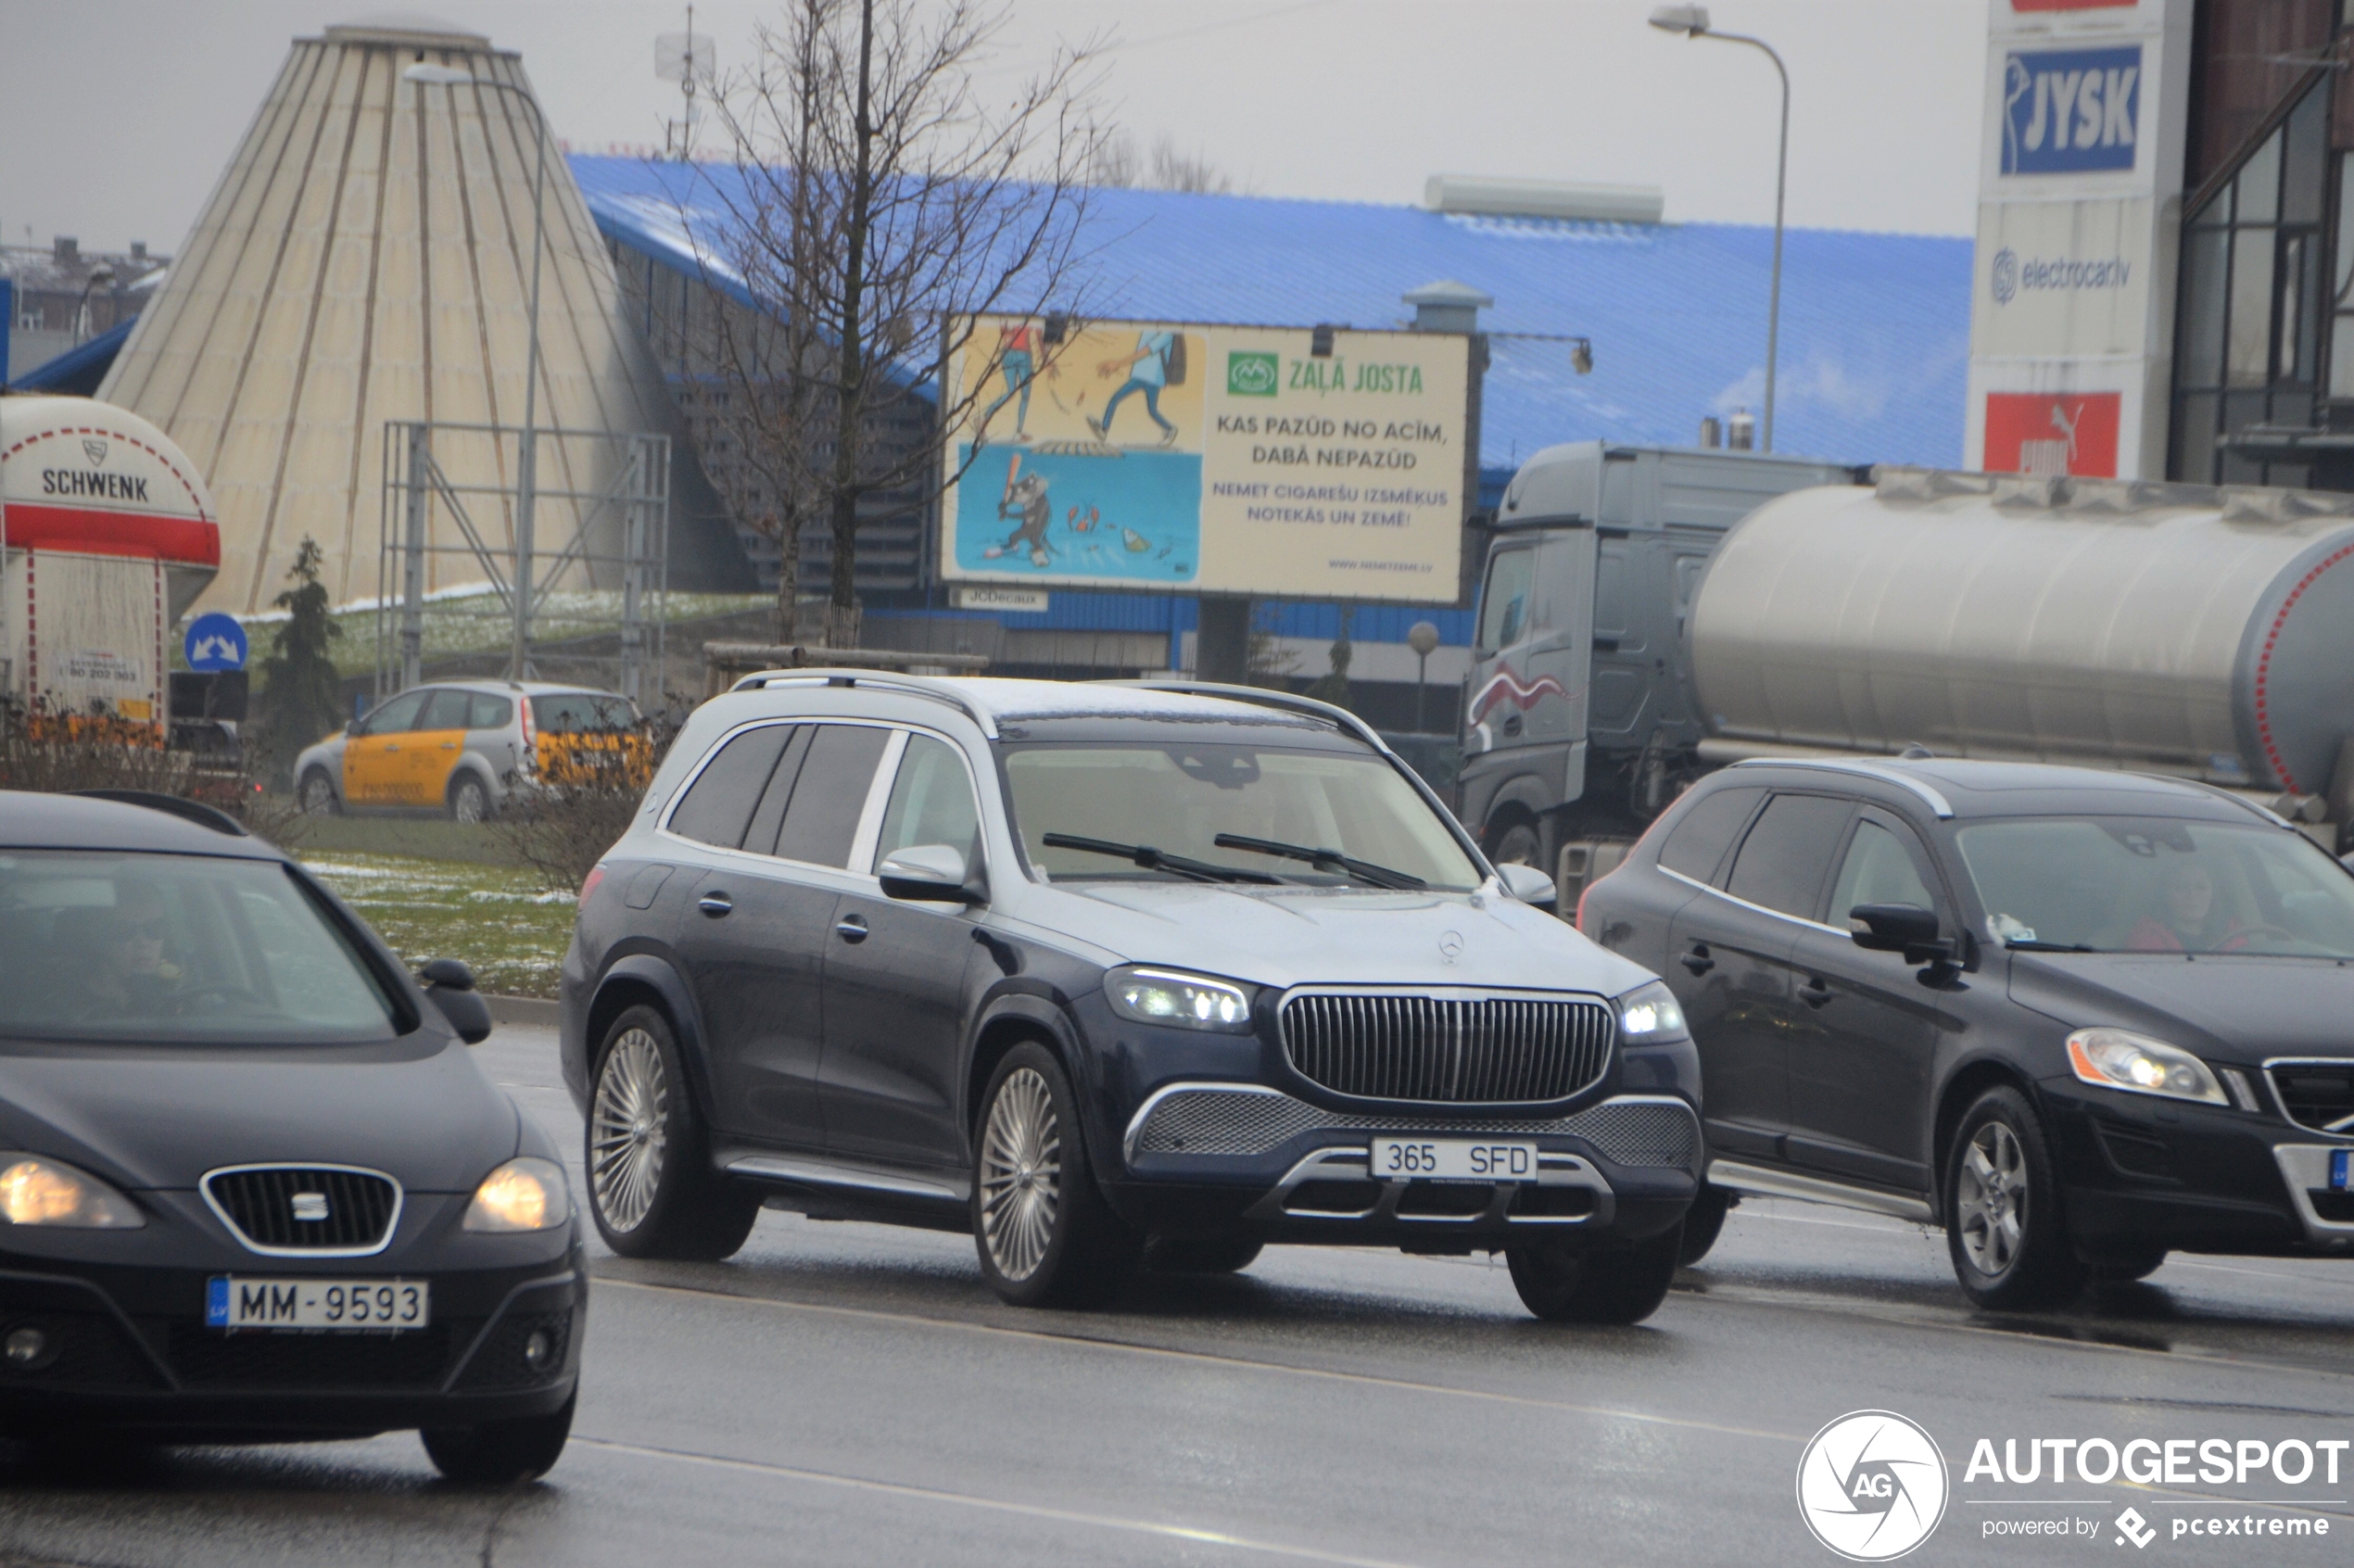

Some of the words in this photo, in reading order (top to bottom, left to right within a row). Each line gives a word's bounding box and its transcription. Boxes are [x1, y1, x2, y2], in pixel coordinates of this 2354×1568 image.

[2024, 68, 2139, 151] JYSK
[2022, 256, 2132, 289] electrocar.lv
[1289, 356, 1346, 398] ZAĻĀ
[1354, 362, 1423, 395] JOSTA
[1218, 415, 1259, 435] KAS
[1266, 415, 1335, 437] PAZŪD
[1345, 421, 1377, 439] NO
[1384, 420, 1448, 446] ACĪM,
[1253, 445, 1310, 465] DABĀ
[1317, 448, 1417, 470] NEPAZŪD
[43, 469, 148, 502] SCHWENK
[1213, 482, 1270, 499] NEMET
[1274, 483, 1359, 502] CIGAREŠU
[1247, 505, 1325, 525] NOTEKĀS
[1330, 512, 1355, 526] UN
[1361, 511, 1411, 528] ZEMĒ!
[970, 588, 1036, 605] JCDecaux
[1387, 1144, 1436, 1171] 365
[1470, 1146, 1529, 1174] SFD
[240, 1284, 419, 1321] MM-9593
